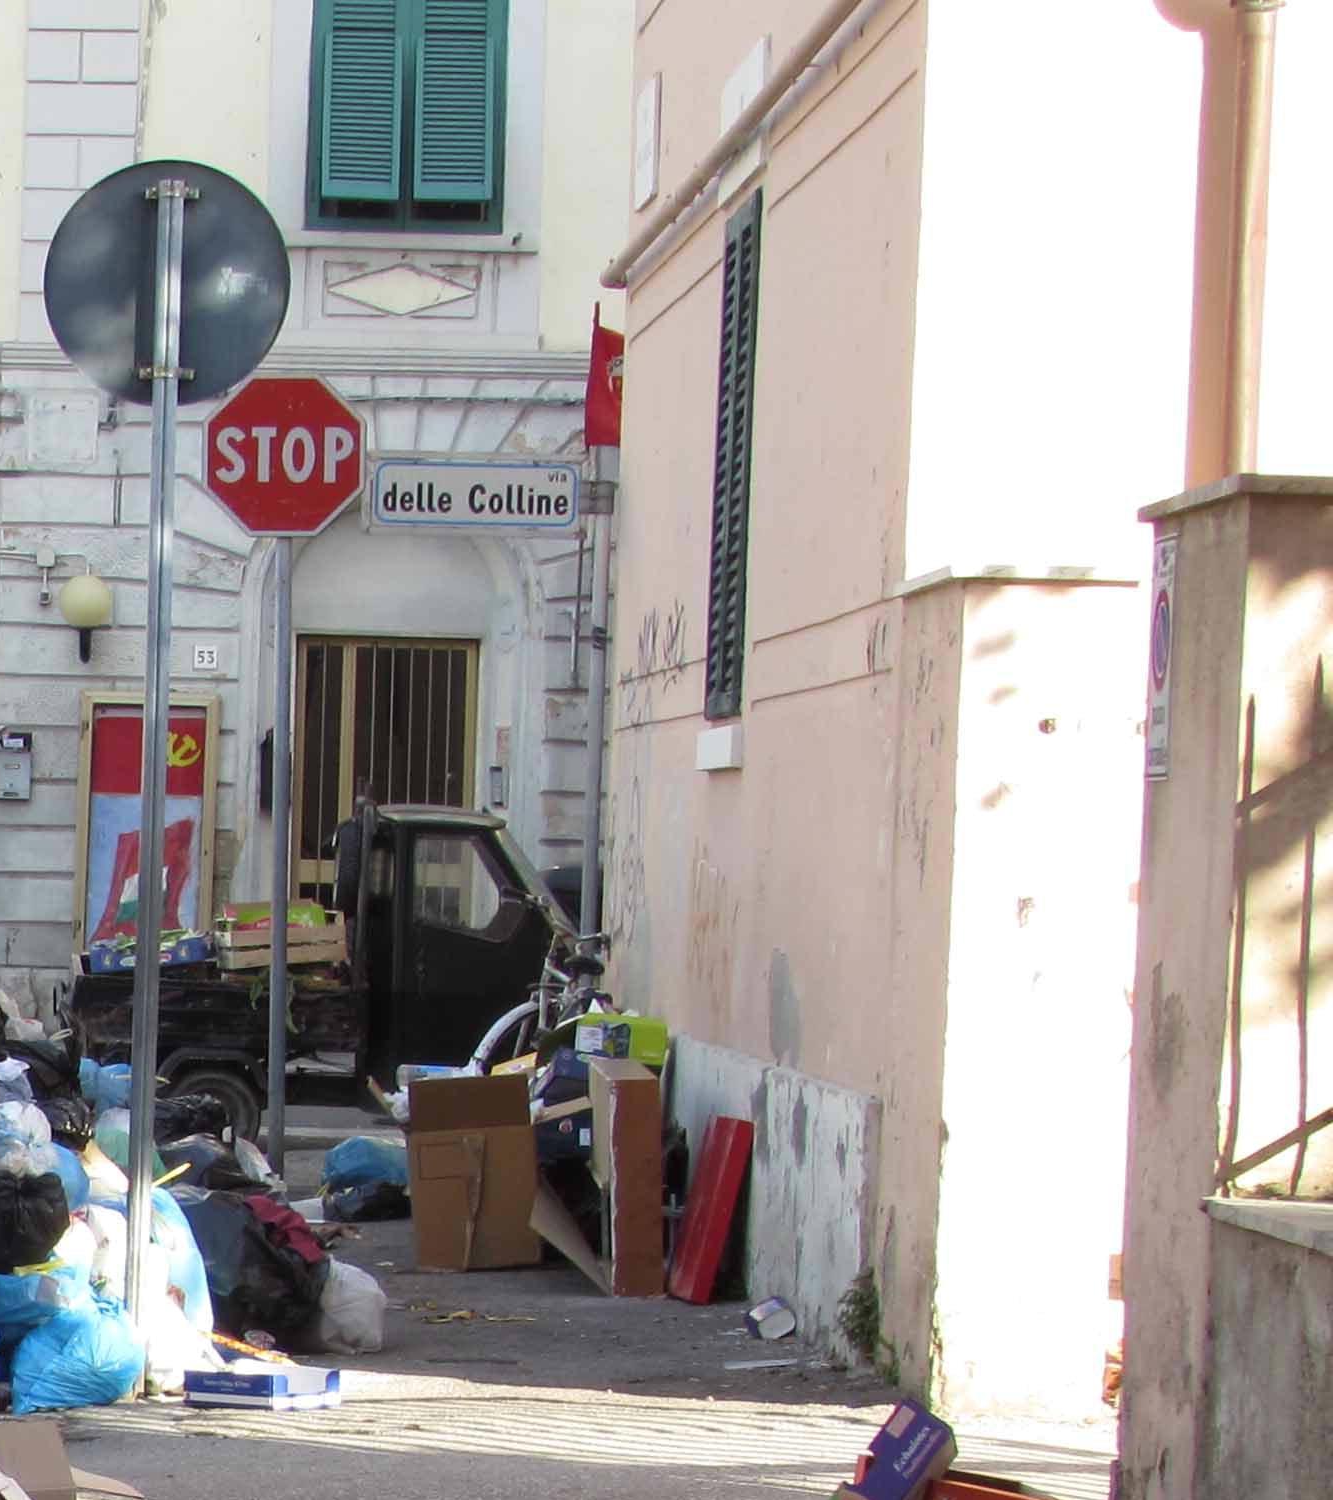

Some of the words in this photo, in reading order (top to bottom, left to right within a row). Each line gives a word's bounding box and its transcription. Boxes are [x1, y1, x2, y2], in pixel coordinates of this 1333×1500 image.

[215, 426, 354, 484] STOP
[548, 471, 568, 484] via
[383, 482, 453, 513] delle
[468, 483, 570, 516] Colline
[197, 650, 215, 665] 53
